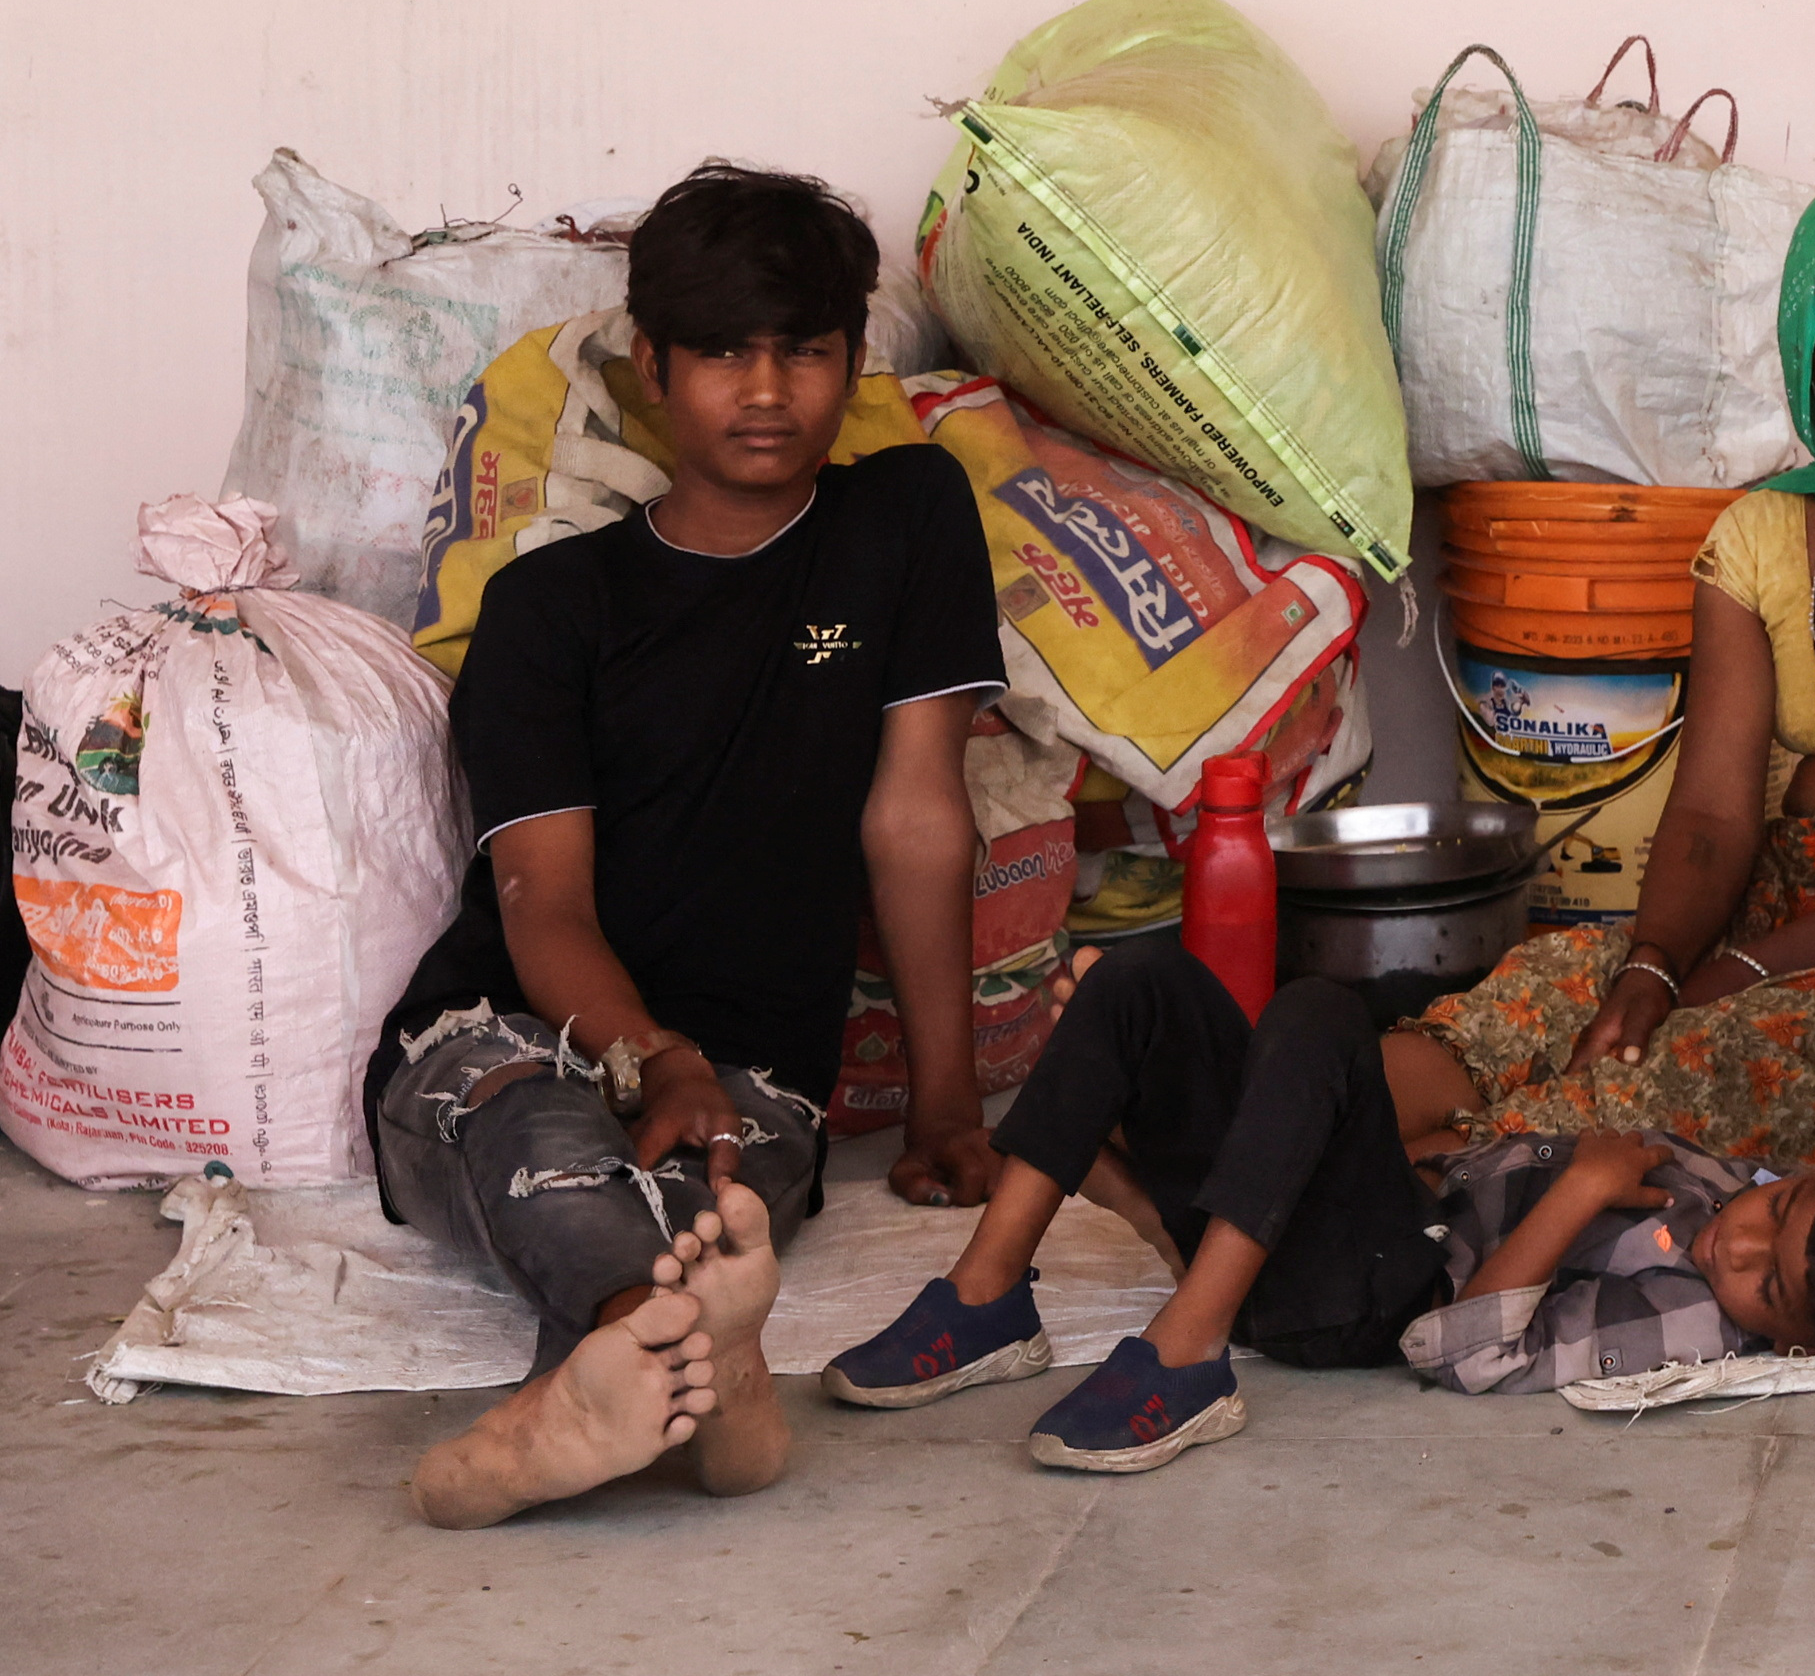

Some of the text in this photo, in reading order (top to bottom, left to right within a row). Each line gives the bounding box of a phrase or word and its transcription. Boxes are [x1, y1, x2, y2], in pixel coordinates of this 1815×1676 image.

[1014, 221, 1056, 264] INDIA
[1050, 259, 1143, 354] SELF-RELIANT
[1135, 350, 1207, 424] FARMERS,
[1158, 409, 1172, 423] at
[1169, 421, 1184, 436] us
[1181, 434, 1206, 459] mail
[1198, 420, 1284, 508] EMPOWERED
[1202, 457, 1216, 471] or
[1495, 715, 1608, 740] SONALIKA
[1554, 742, 1609, 756] HYDRAULIC
[114, 1020, 154, 1033] Purpose
[157, 1021, 182, 1034] Only
[39, 1071, 196, 1110] FERTILISERS
[117, 1110, 232, 1135] LIMITED
[150, 1135, 176, 1150] Code
[185, 1140, 234, 1157] 325208.
